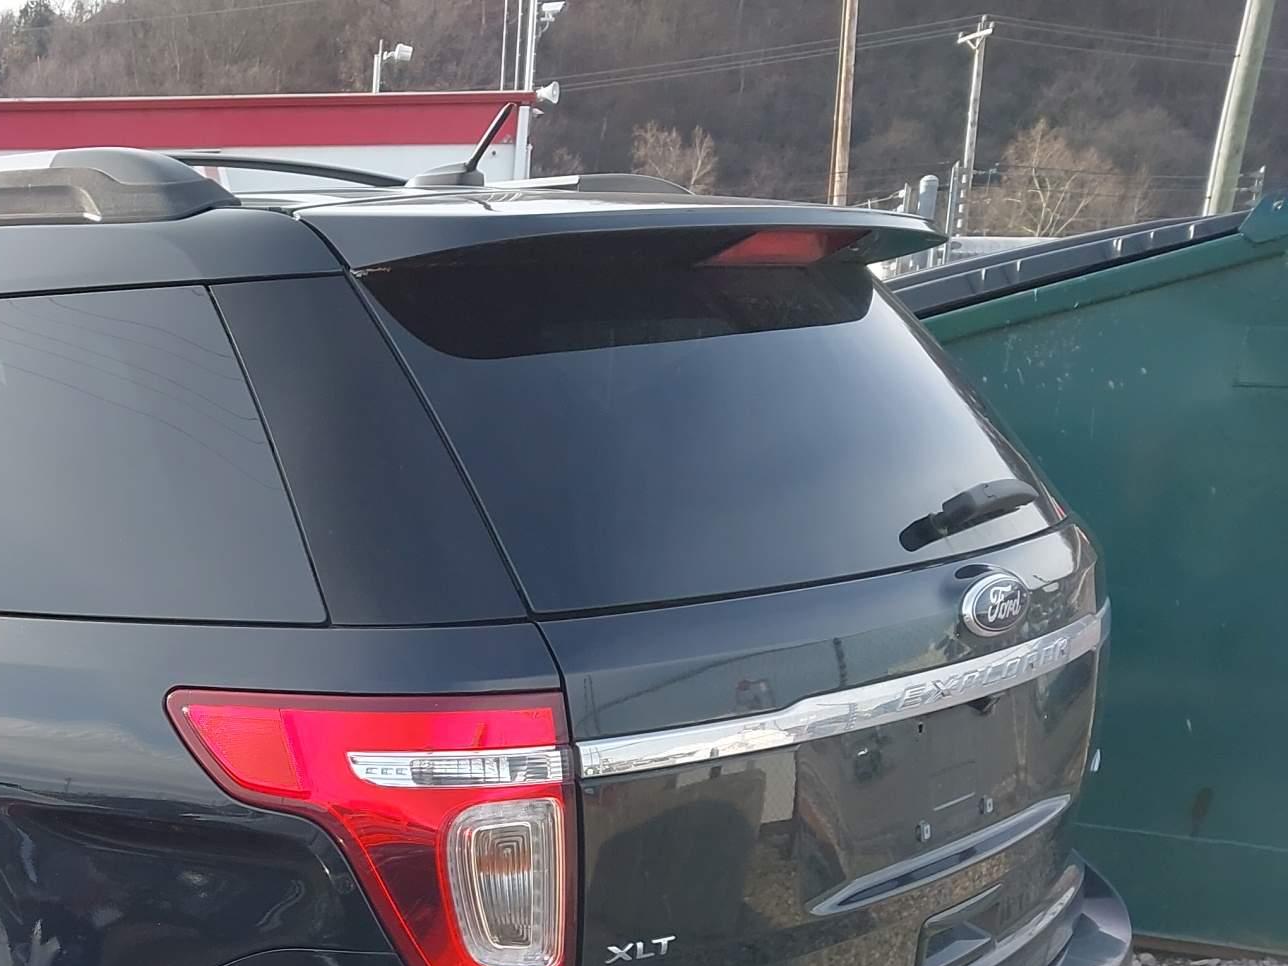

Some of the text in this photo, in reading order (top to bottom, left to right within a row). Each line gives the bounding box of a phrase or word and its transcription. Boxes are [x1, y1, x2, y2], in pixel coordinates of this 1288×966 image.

[987, 585, 1022, 623] Ford
[895, 636, 1070, 711] EXPLORER
[605, 935, 677, 964] XLT
